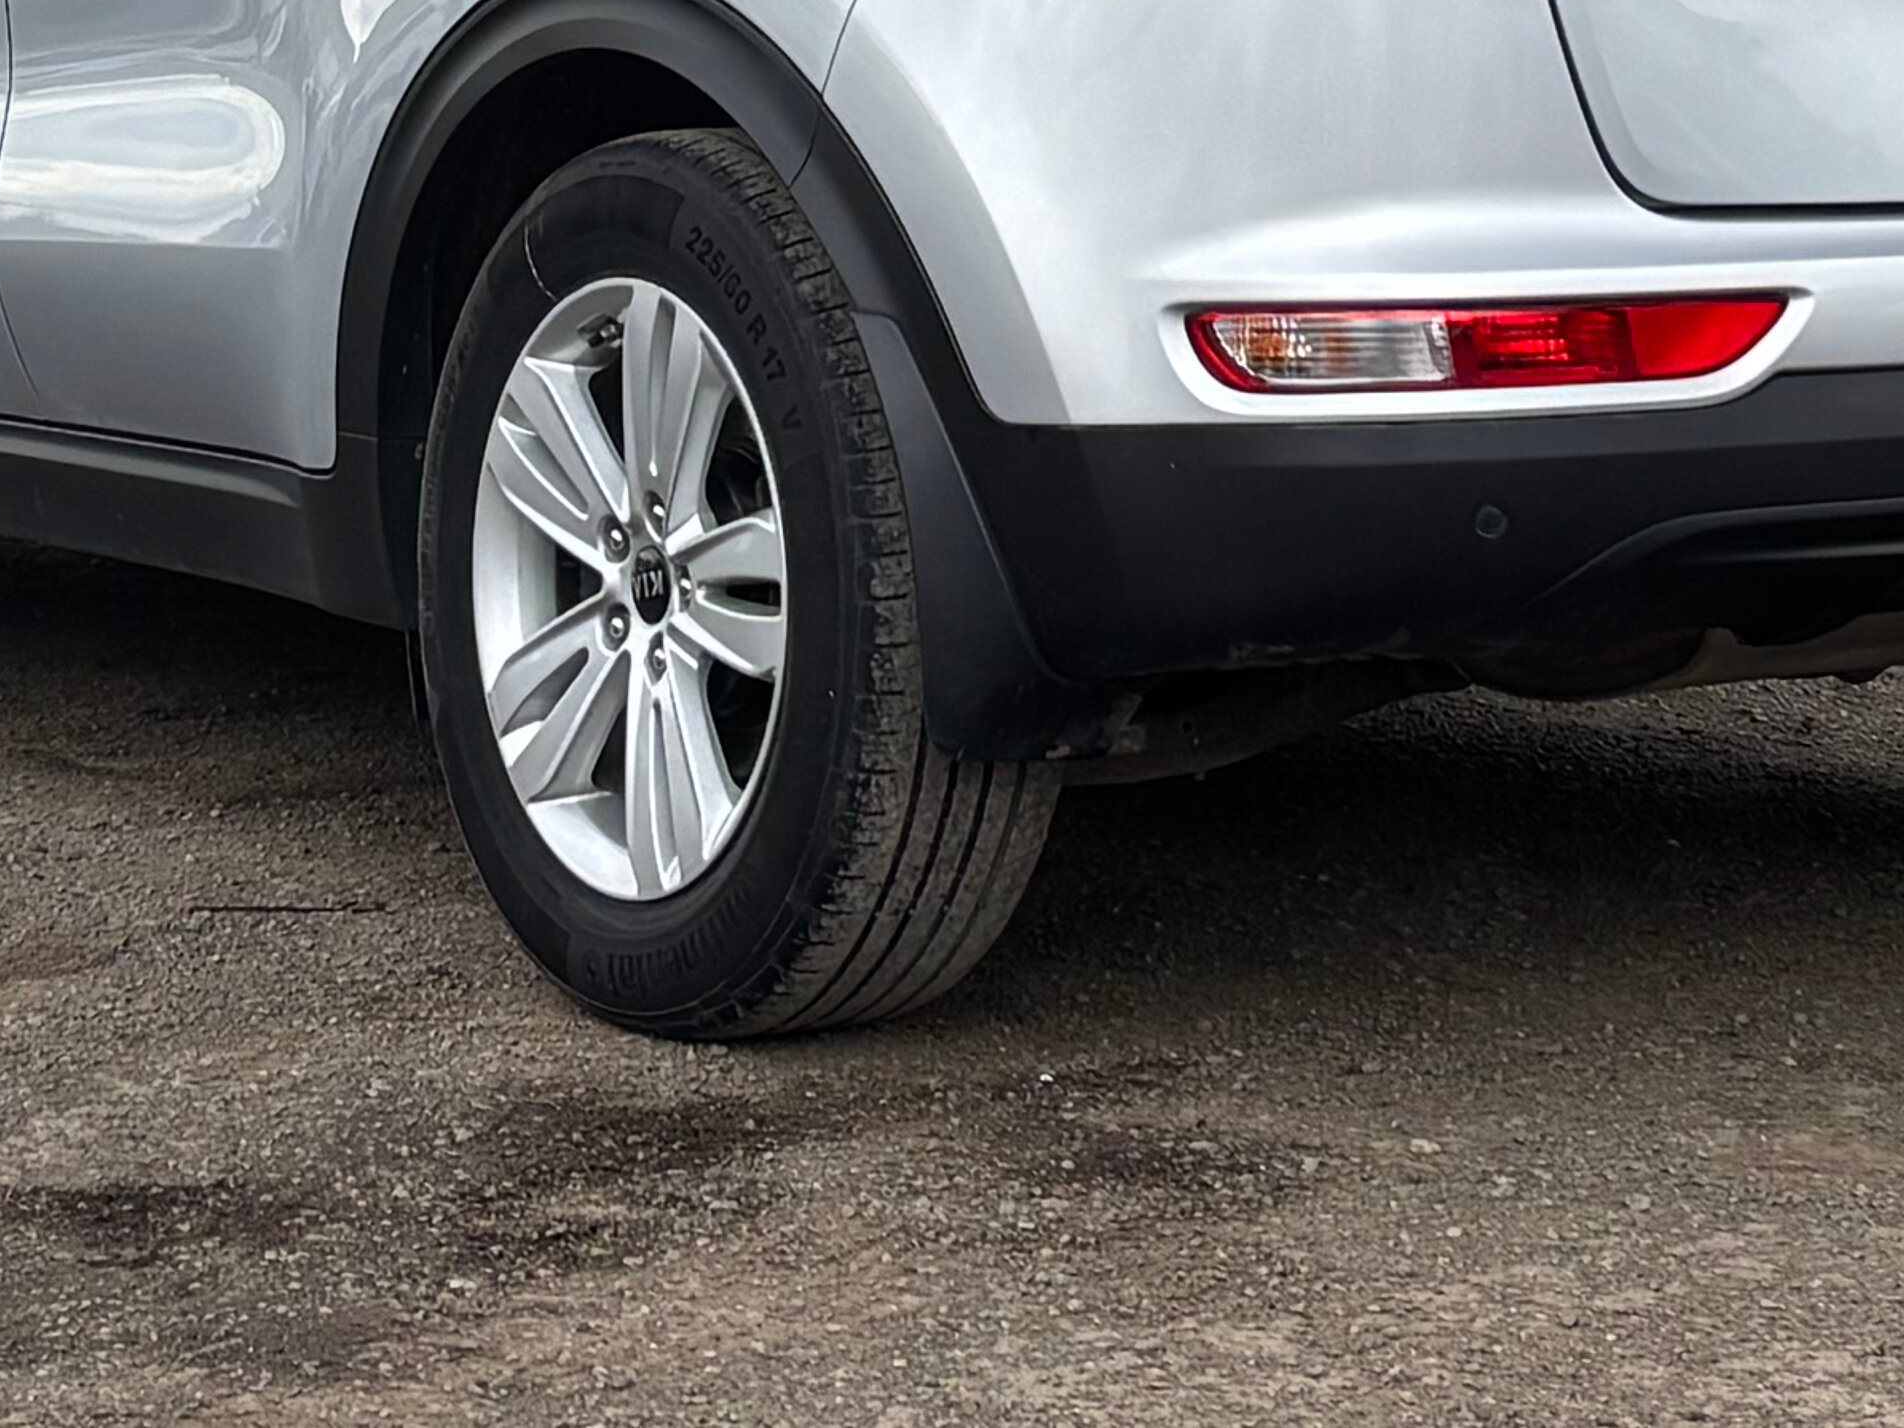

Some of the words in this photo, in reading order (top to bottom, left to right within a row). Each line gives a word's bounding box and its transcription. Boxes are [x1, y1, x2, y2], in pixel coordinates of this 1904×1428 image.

[746, 312, 769, 346] R
[760, 345, 788, 382] 17
[632, 569, 664, 601] KIA
